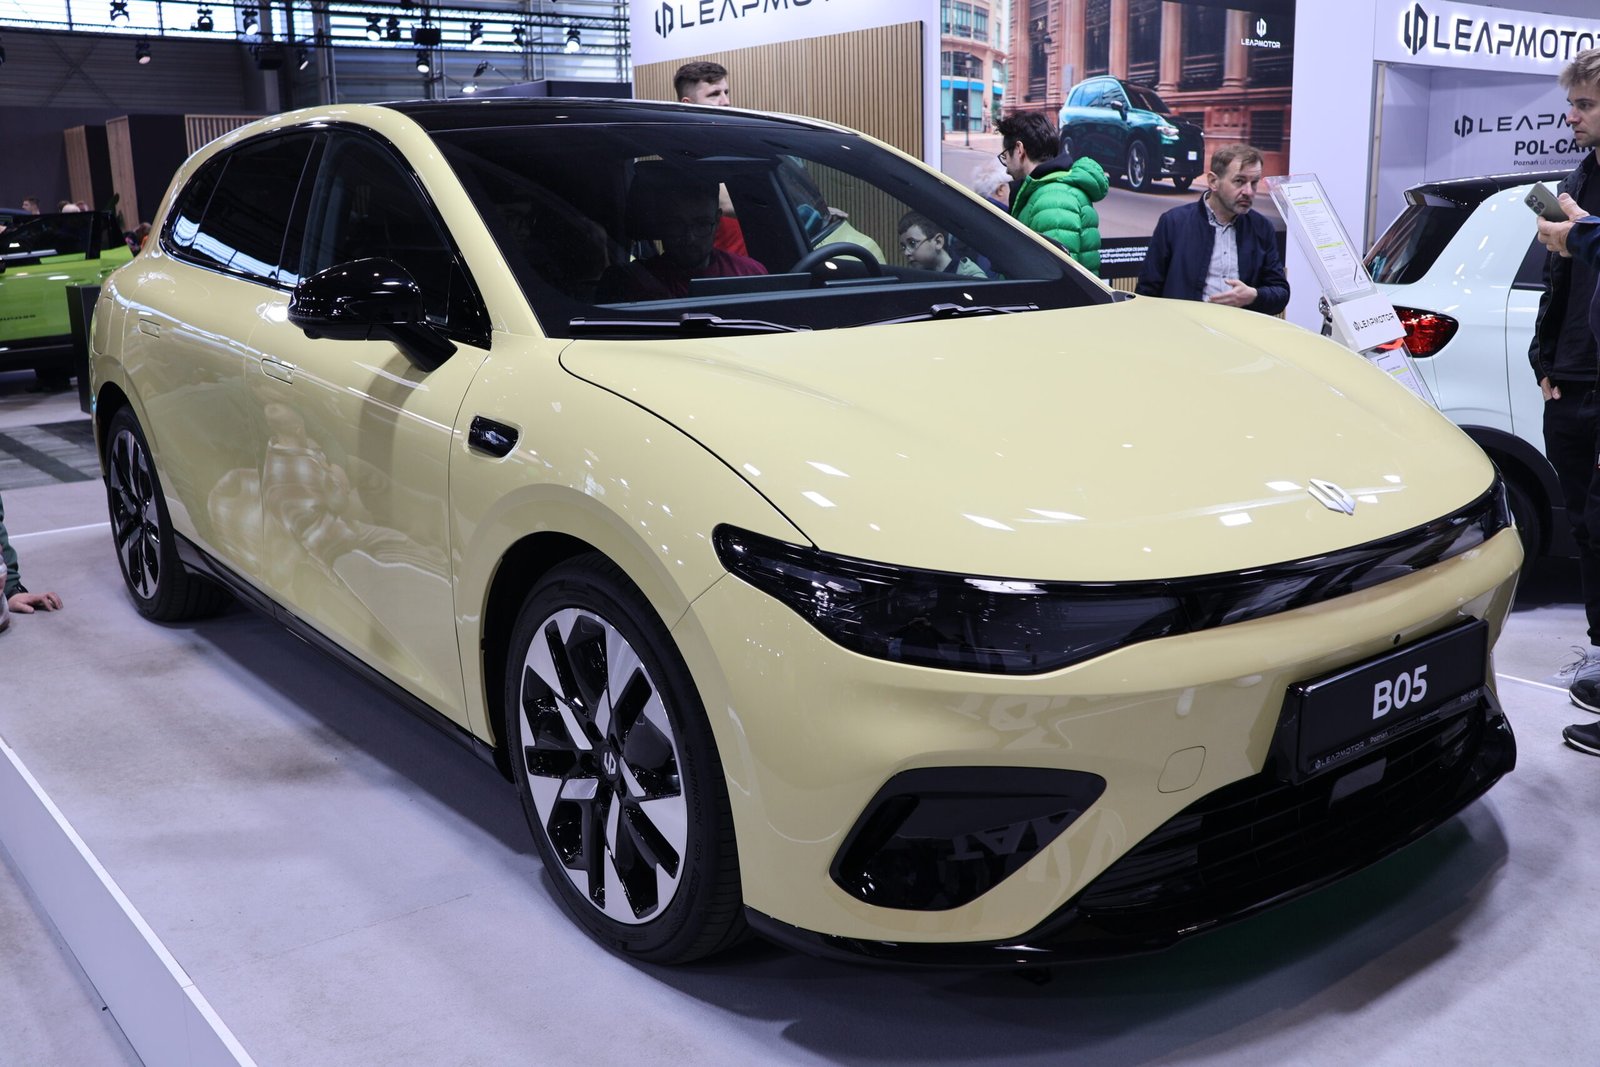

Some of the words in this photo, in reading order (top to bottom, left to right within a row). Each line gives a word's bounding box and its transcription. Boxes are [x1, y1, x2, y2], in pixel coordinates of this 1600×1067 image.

[680, 0, 829, 28] LEAPM
[1240, 38, 1281, 49] LEAPMOTOR
[1433, 15, 1600, 60] LEAPMOTO
[1478, 113, 1571, 133] LEAPM
[1360, 312, 1395, 329] LEAPMOTOR
[1372, 664, 1428, 720] B05
[1321, 741, 1365, 766] LEAPMOTOR
